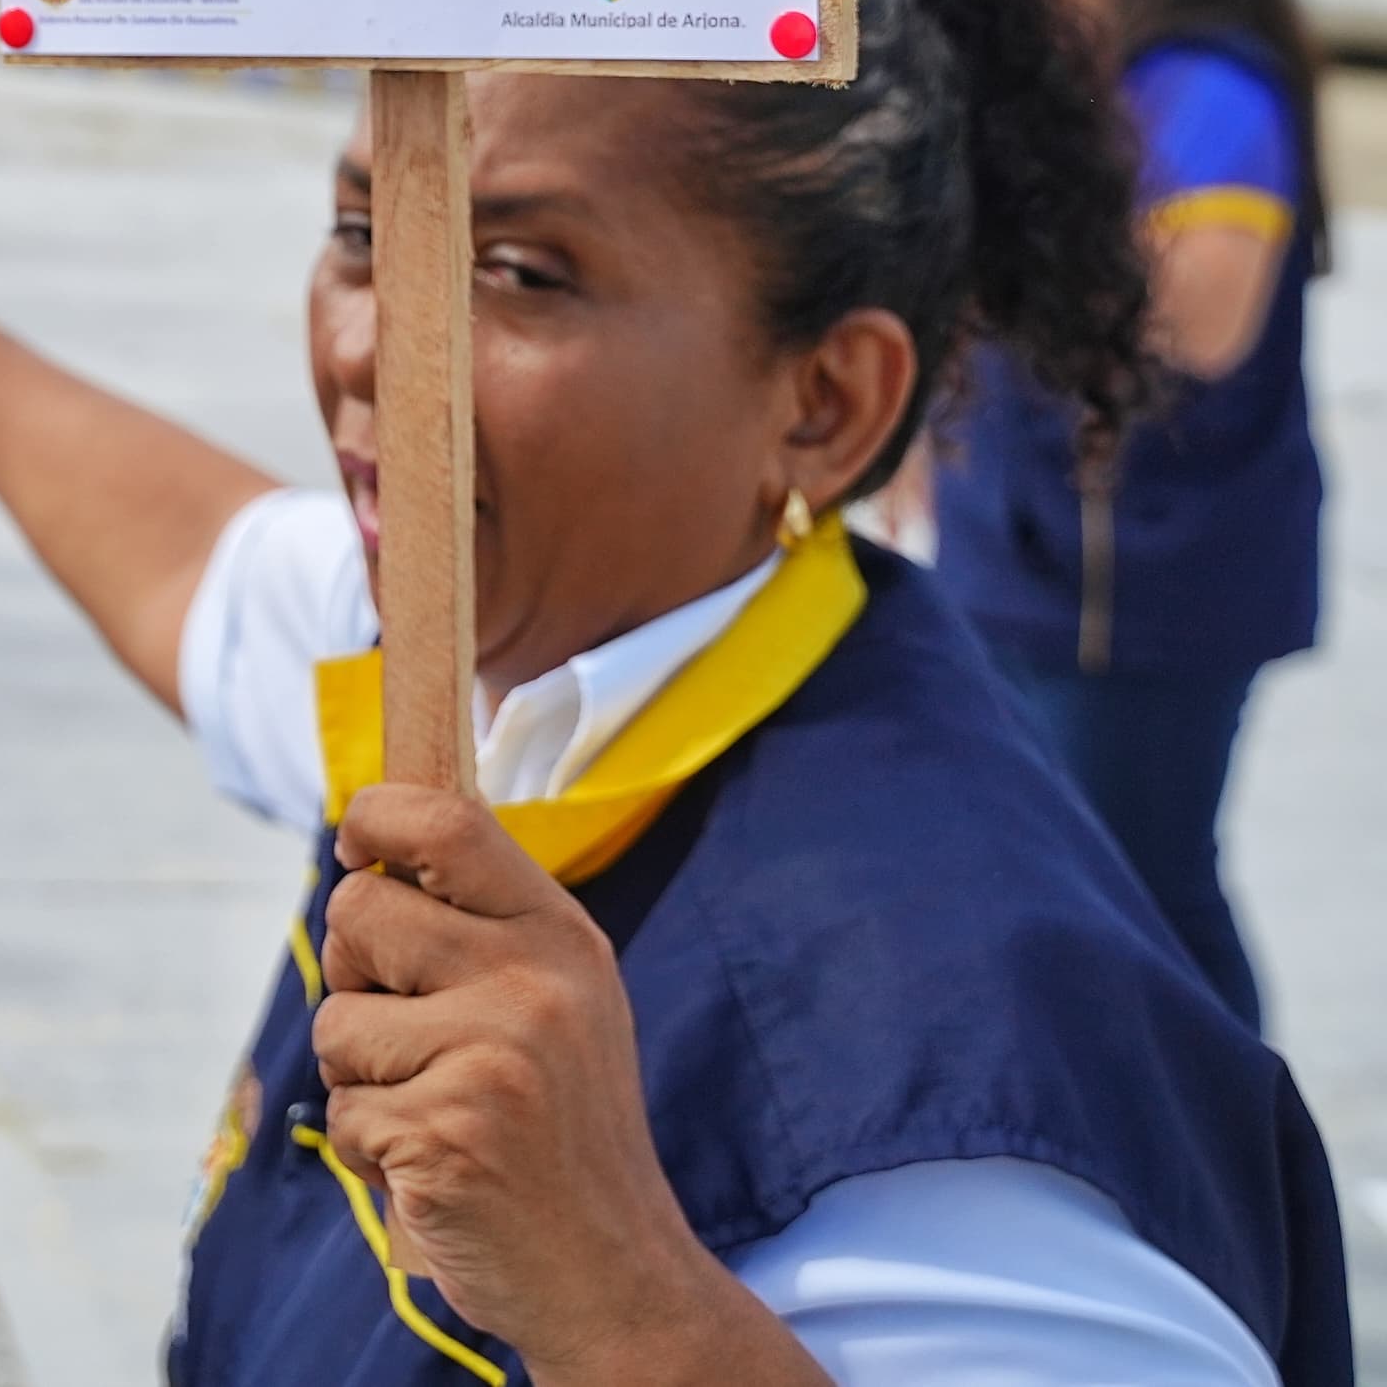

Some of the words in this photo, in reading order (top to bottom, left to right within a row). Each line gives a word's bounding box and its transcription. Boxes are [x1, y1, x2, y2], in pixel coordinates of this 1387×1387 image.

[570, 12, 651, 30] Municipal
[657, 12, 677, 28] de
[682, 12, 747, 31] Arjona.
